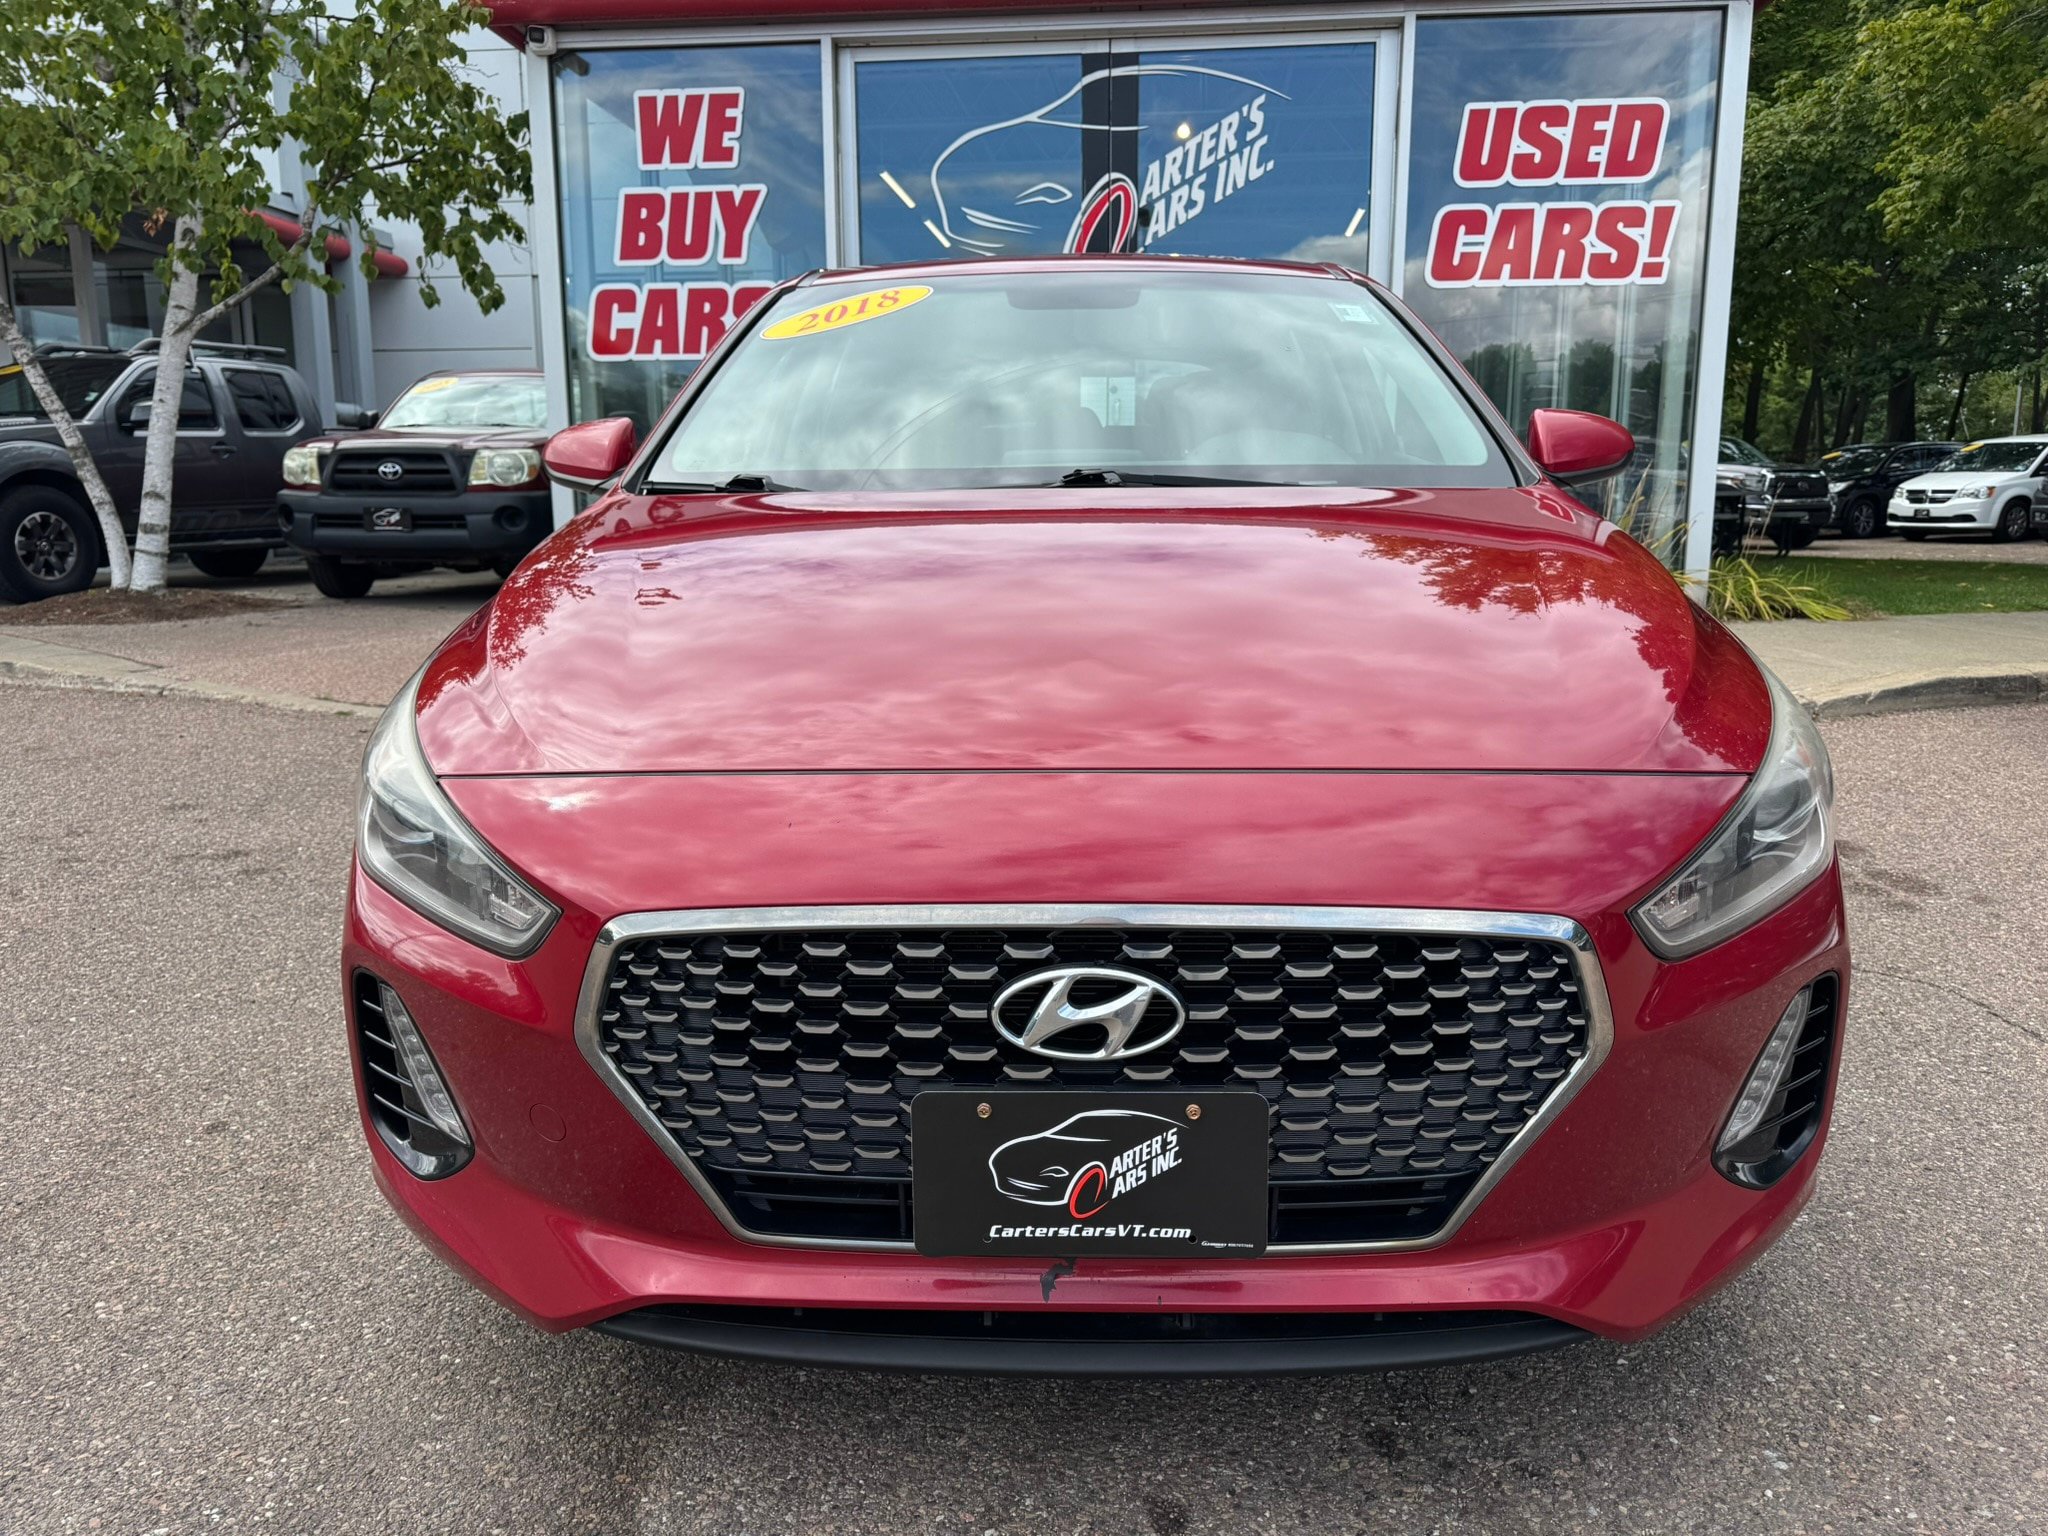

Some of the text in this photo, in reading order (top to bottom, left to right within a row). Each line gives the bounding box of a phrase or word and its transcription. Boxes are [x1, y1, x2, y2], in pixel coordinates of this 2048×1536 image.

[636, 91, 741, 166] WE
[1458, 102, 1665, 183] USED
[1213, 134, 1276, 204] INC.
[617, 188, 763, 263] BUY
[1429, 205, 1677, 283] CARS!
[796, 289, 901, 333] 2018
[1151, 1146, 1182, 1178] INC.
[988, 1224, 1192, 1240] CartersCarsVT.com
